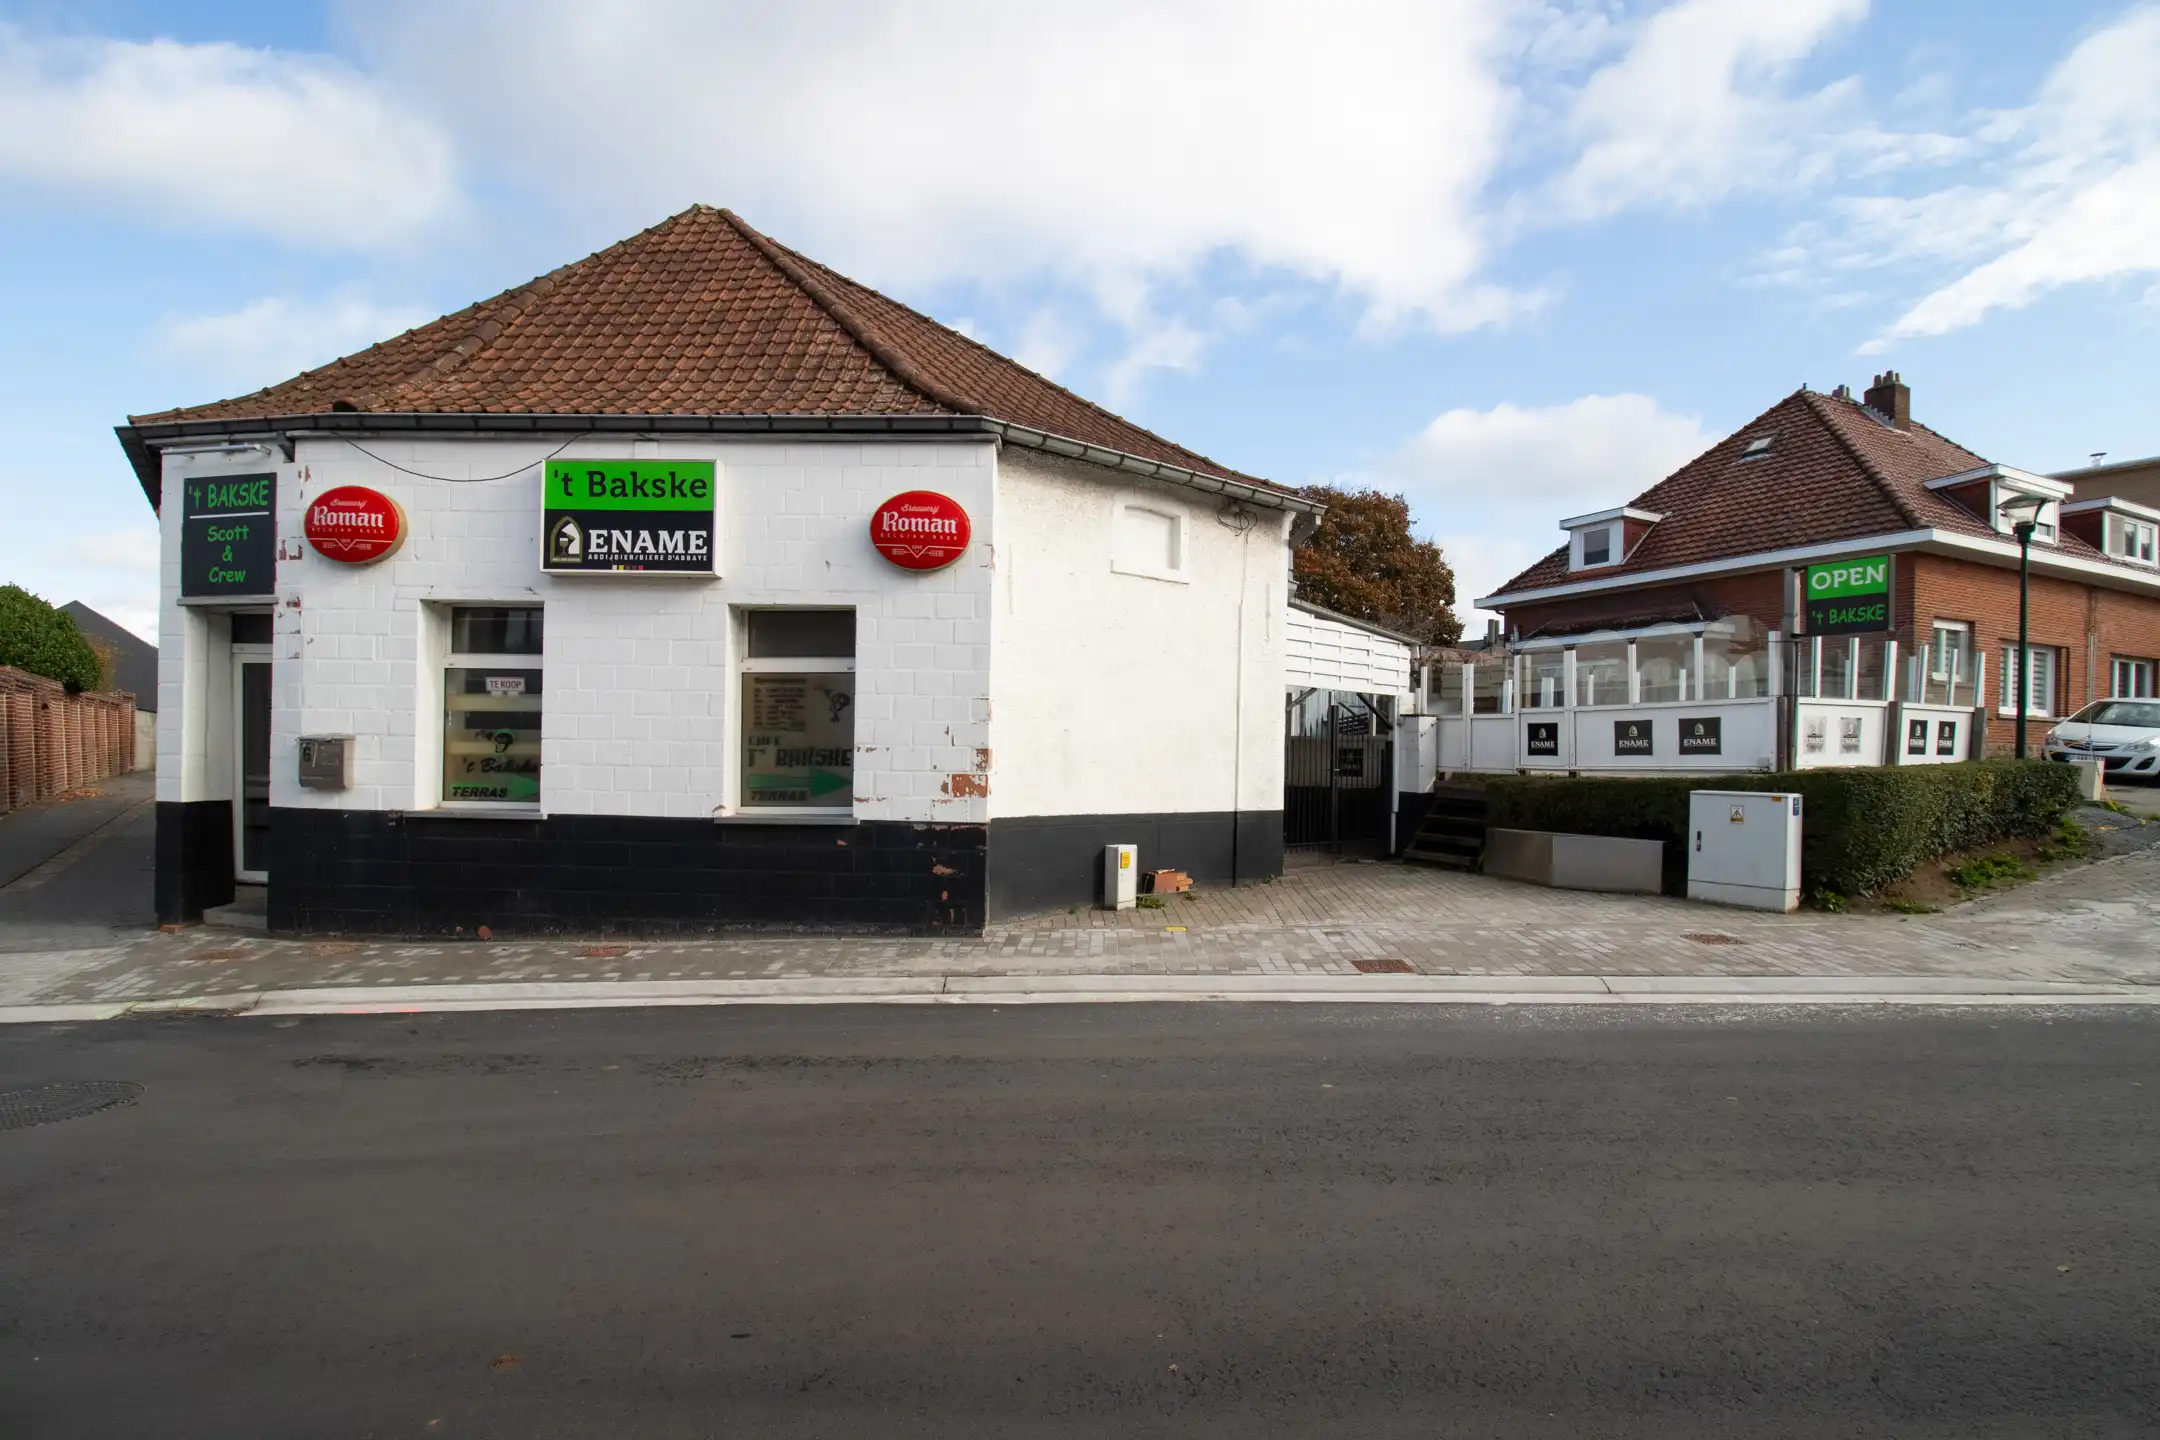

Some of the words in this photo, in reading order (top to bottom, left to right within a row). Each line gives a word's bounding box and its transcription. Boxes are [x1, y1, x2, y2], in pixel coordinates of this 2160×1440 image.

[554, 469, 573, 497] 't
[586, 471, 707, 498] Bakske
[188, 485, 201, 509] 't
[207, 480, 270, 508] BAKSKE
[312, 506, 384, 528] Roman
[882, 511, 958, 534] Roman
[207, 525, 249, 542] Scott
[588, 529, 708, 554] ENAME
[222, 546, 233, 562] &
[208, 567, 246, 583] Crew
[1811, 564, 1885, 590] OPEN
[1812, 610, 1824, 626] 't
[1829, 603, 1885, 625] BAKSKE
[489, 680, 500, 689] TE
[501, 680, 522, 689] KOOP
[1531, 740, 1555, 748] ENAME
[1619, 739, 1649, 747] ENAME
[1684, 737, 1717, 745] ENAME
[452, 786, 508, 798] TERRAS
